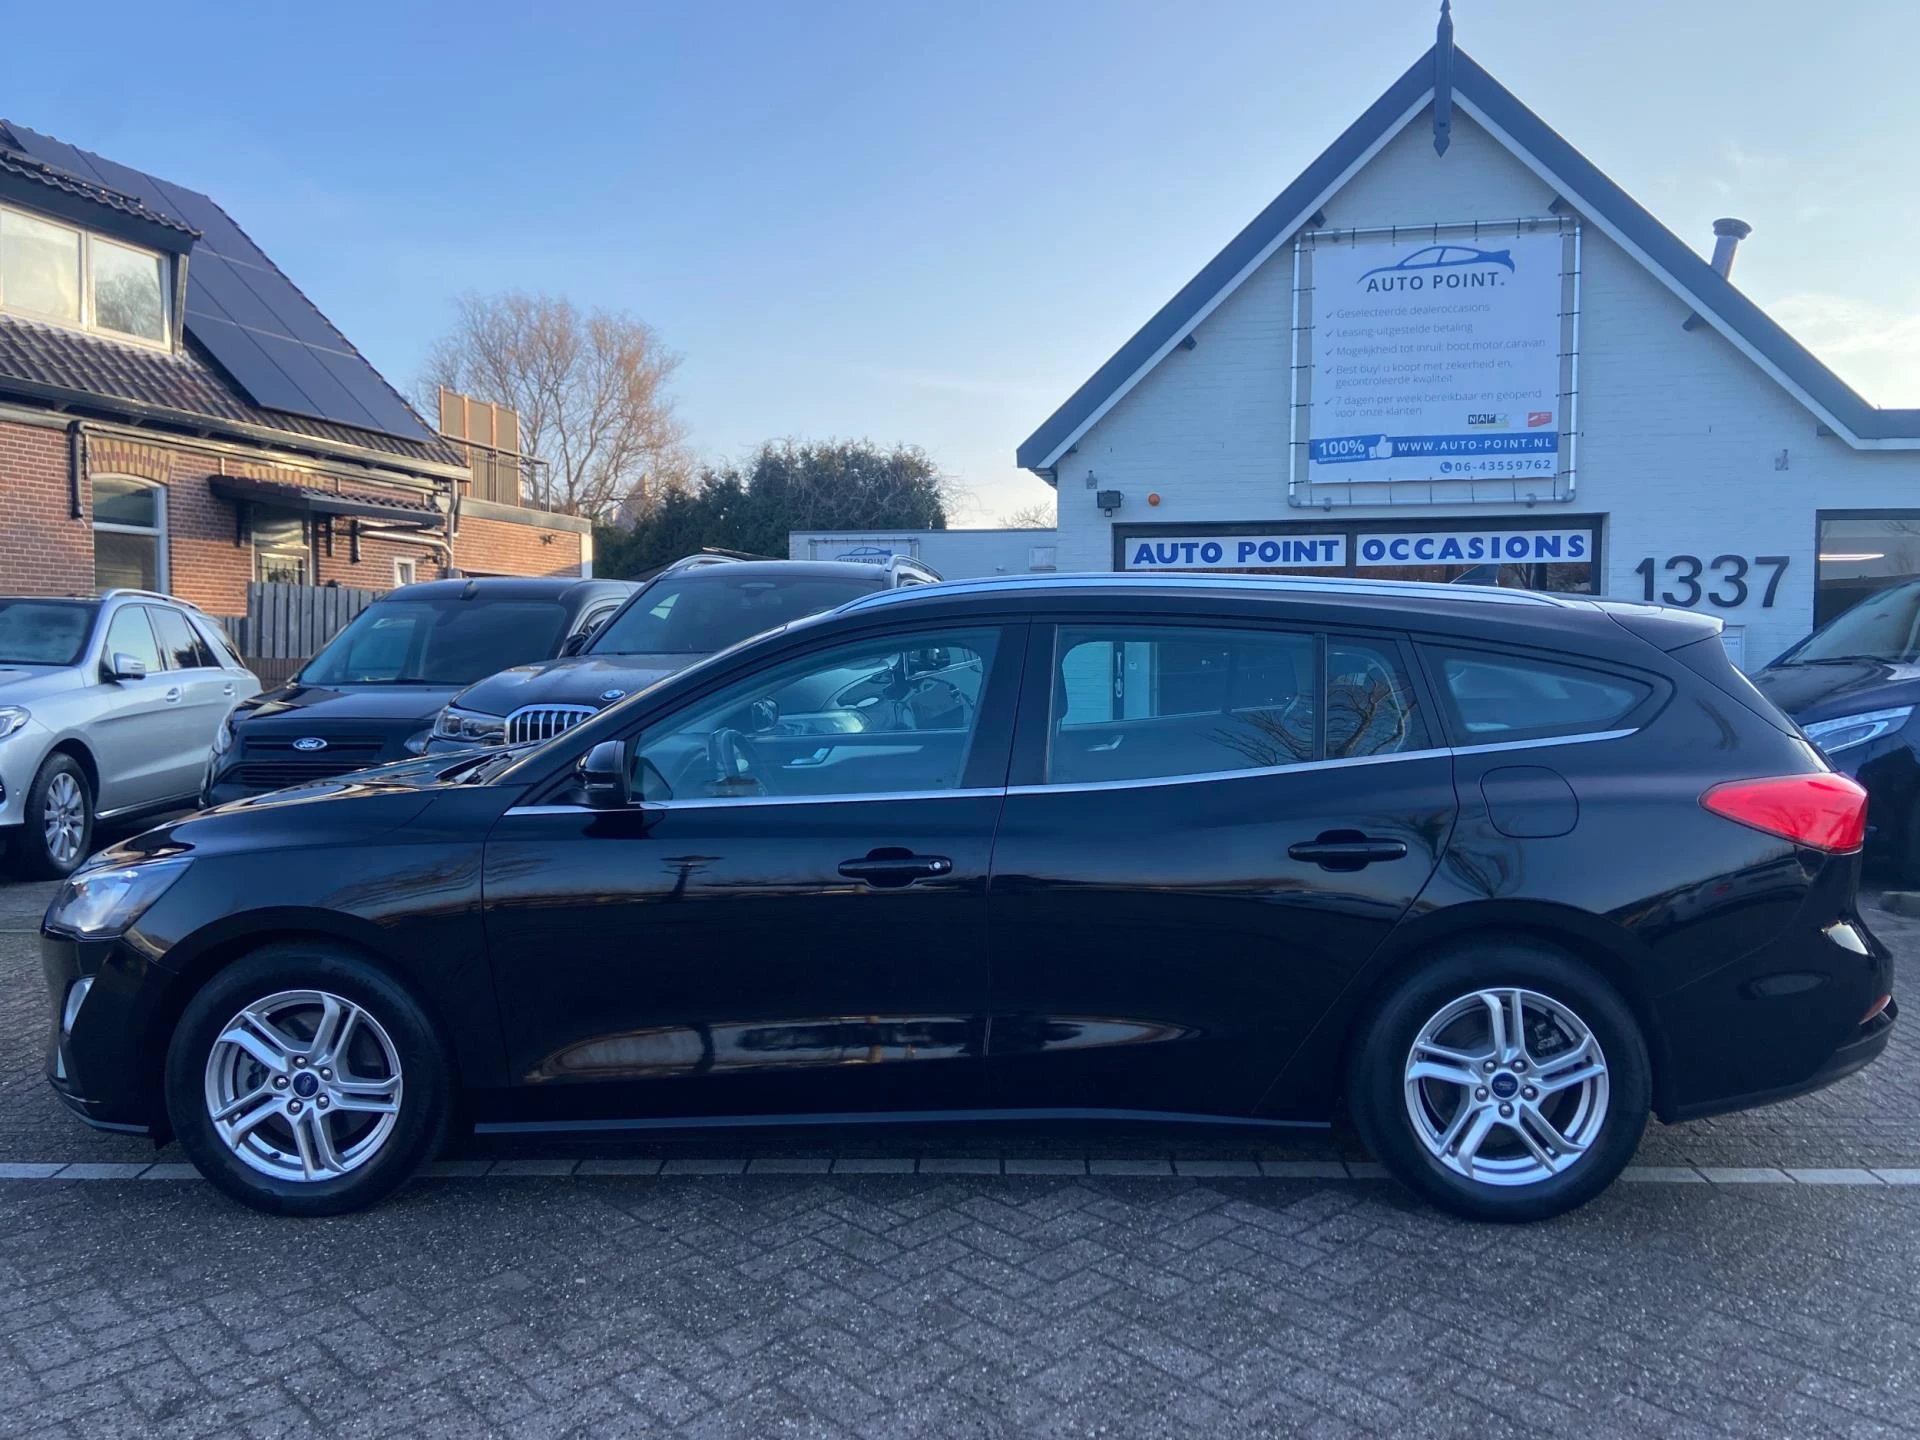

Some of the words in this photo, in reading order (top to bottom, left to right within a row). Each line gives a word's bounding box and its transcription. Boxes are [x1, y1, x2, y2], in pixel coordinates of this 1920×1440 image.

[1366, 275, 1424, 293] AUTO
[1336, 305, 1408, 319] Geselecteerde
[1409, 303, 1491, 316] dealeroccasions
[1433, 321, 1473, 334] betaling
[1336, 343, 1398, 358] Mogelijkheid
[1399, 343, 1414, 353] tot
[1336, 365, 1357, 375] Best
[1392, 362, 1421, 375] koopt
[1423, 361, 1443, 371] met
[1446, 358, 1495, 370] zekerheid
[1335, 375, 1412, 389] gecontroleerde
[1413, 373, 1453, 385] kwaliteit
[1335, 396, 1342, 405] 7
[1344, 395, 1375, 407] dagen
[1376, 395, 1393, 406] per
[1396, 392, 1422, 403] week
[1424, 388, 1478, 402] bereikbaar
[1480, 390, 1494, 400] en
[1496, 388, 1542, 402] geopend
[1335, 409, 1356, 418] voor
[1359, 408, 1383, 417] onze
[1385, 405, 1422, 416] klanten
[1319, 439, 1365, 456] 100%
[1397, 438, 1552, 452] WWW.AUTO-POINT.NL
[1454, 459, 1552, 472] 06-43559762
[1133, 541, 1223, 564] AUTO
[1237, 540, 1339, 563] POINT
[1361, 534, 1586, 561] OCCASIONS
[1634, 554, 1790, 609] 1337
